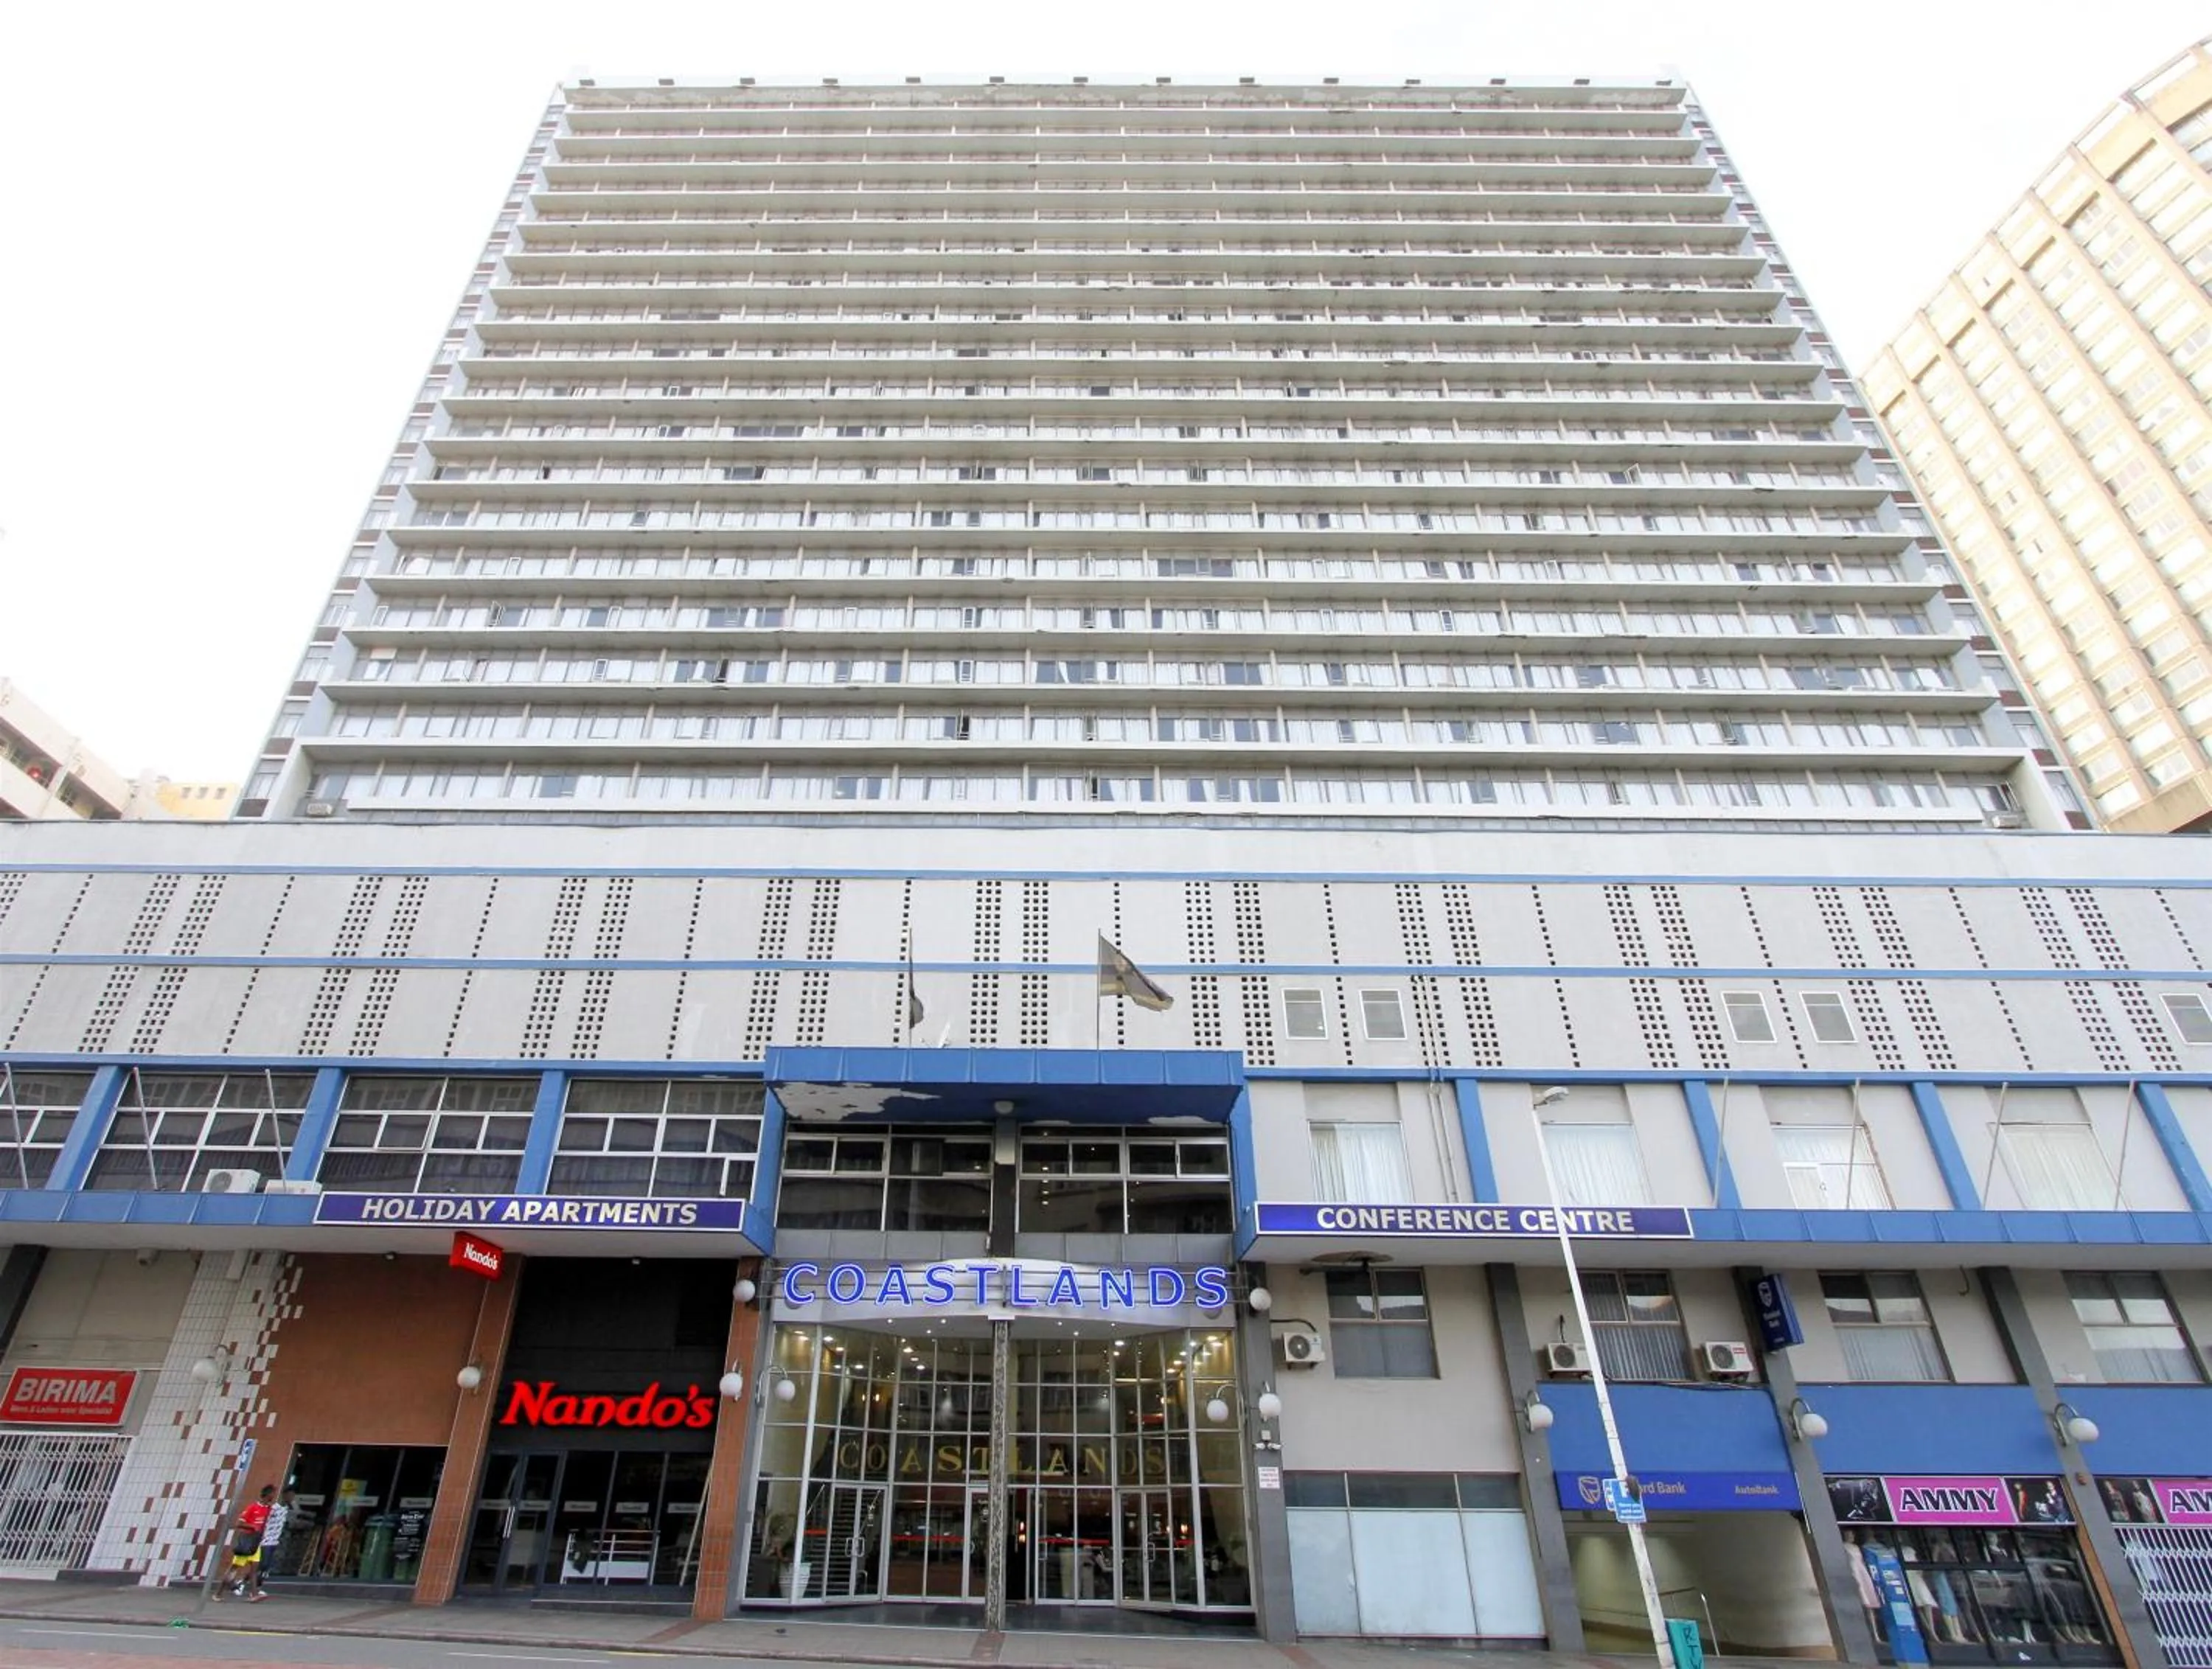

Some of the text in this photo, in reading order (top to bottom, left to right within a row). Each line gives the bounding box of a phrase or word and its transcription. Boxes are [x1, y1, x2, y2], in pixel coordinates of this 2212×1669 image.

[361, 1198, 697, 1225] HOLIDAY APARTMENTS
[1316, 1207, 1635, 1232] CONFERENCE CENTRE
[463, 1242, 498, 1270] Nando's
[783, 1262, 1229, 1310] COASTLANDS
[15, 1377, 117, 1404] BIRIMA
[498, 1380, 715, 1429] Nando's
[839, 1441, 1167, 1474] COASTLANDS
[1657, 1481, 1686, 1494] Bank
[1899, 1487, 1999, 1513] AMMY
